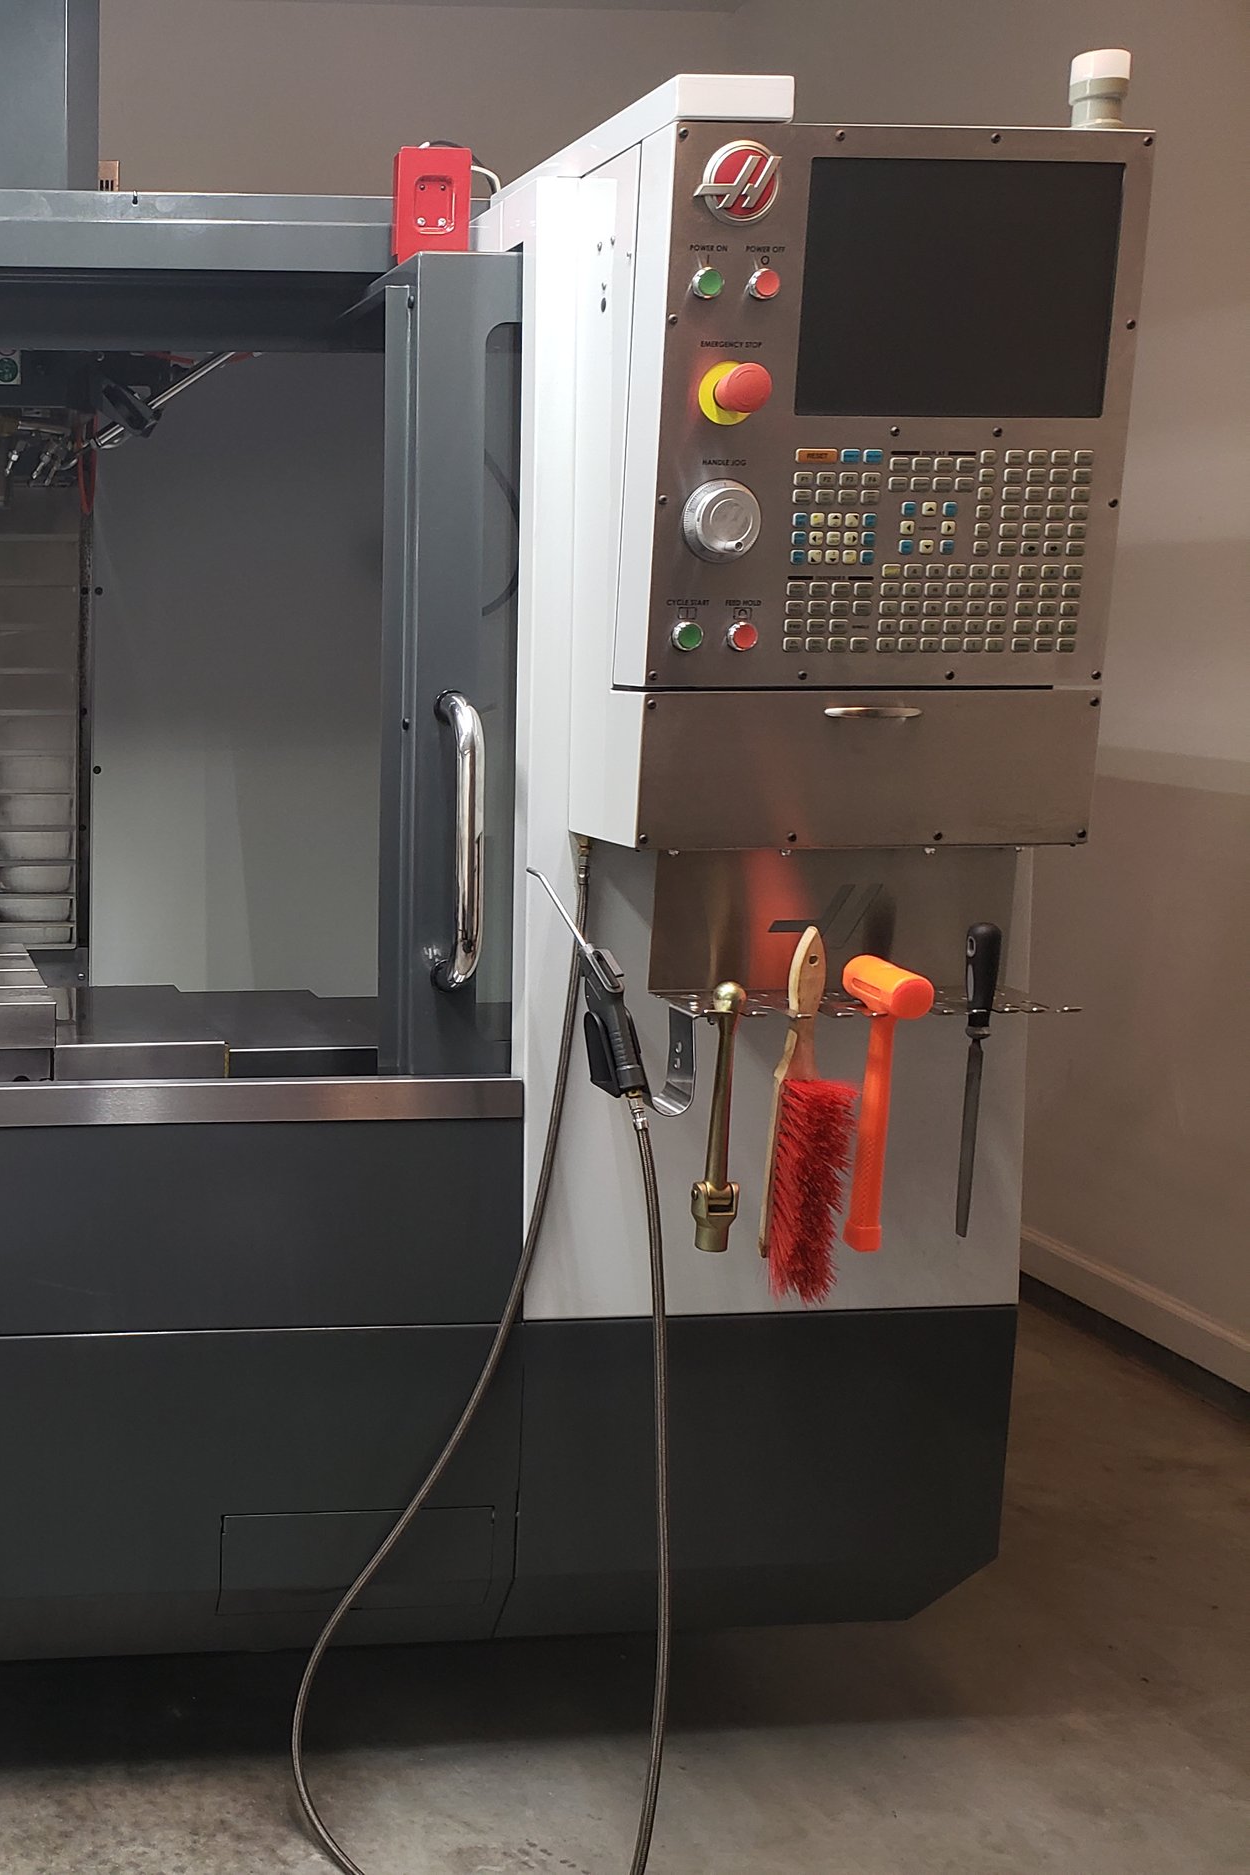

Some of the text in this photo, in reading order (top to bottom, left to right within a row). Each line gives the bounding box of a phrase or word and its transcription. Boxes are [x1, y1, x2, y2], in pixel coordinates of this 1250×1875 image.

[689, 244, 714, 252] POWER
[745, 245, 770, 253] POWER
[700, 340, 744, 348] EMERGENCY
